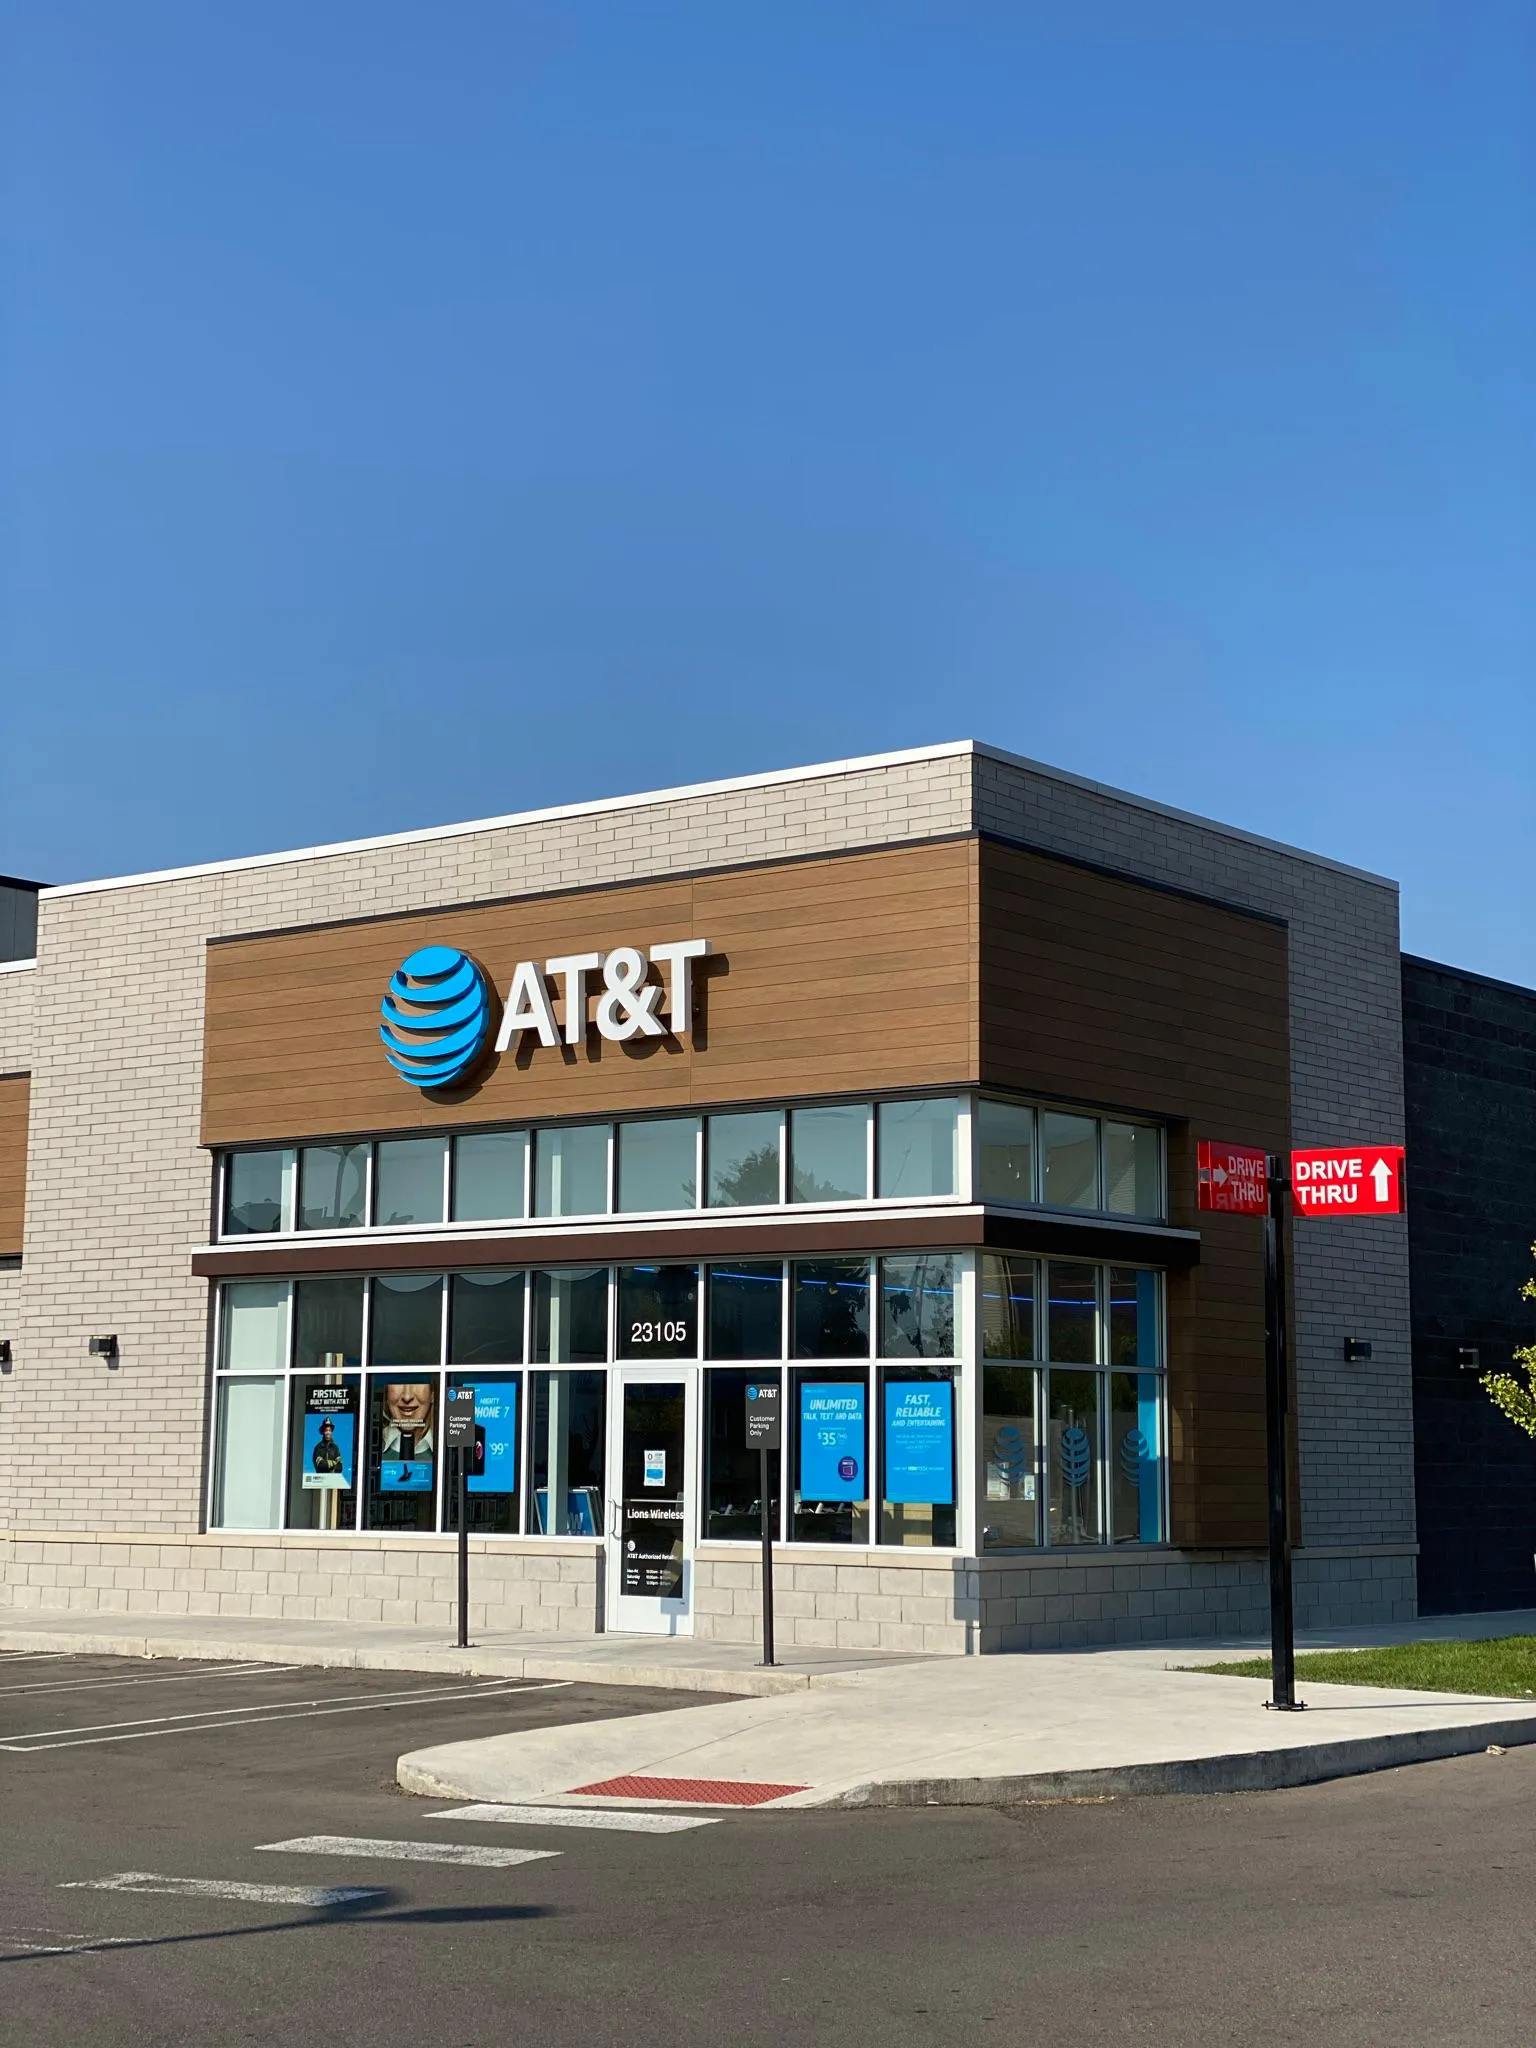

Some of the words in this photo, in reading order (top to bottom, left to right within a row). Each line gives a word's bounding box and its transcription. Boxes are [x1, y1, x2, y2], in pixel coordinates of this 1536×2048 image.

[494, 939, 712, 1053] AT&T
[1228, 1155, 1264, 1179] DRIVE
[1296, 1158, 1362, 1180] DRIVE
[1231, 1180, 1264, 1203] THRU
[1297, 1184, 1357, 1205] THRU
[631, 1321, 686, 1342] 23105
[312, 1389, 348, 1398] FIRSTNET
[457, 1391, 473, 1400] AT&T
[758, 1389, 777, 1398] AT&T
[810, 1399, 858, 1410] UNLIMITED
[905, 1394, 930, 1406] FAST,
[503, 1406, 510, 1418] 7
[820, 1412, 834, 1420] TEXT
[835, 1412, 847, 1420] AND
[847, 1412, 862, 1420] DATA
[895, 1407, 942, 1417] RELIABLE
[449, 1422, 467, 1430] Parking
[749, 1422, 769, 1430] Parking
[749, 1429, 763, 1437] Only
[817, 1431, 836, 1446] $35
[627, 1509, 649, 1519] Lions
[650, 1509, 685, 1519] Wireless
